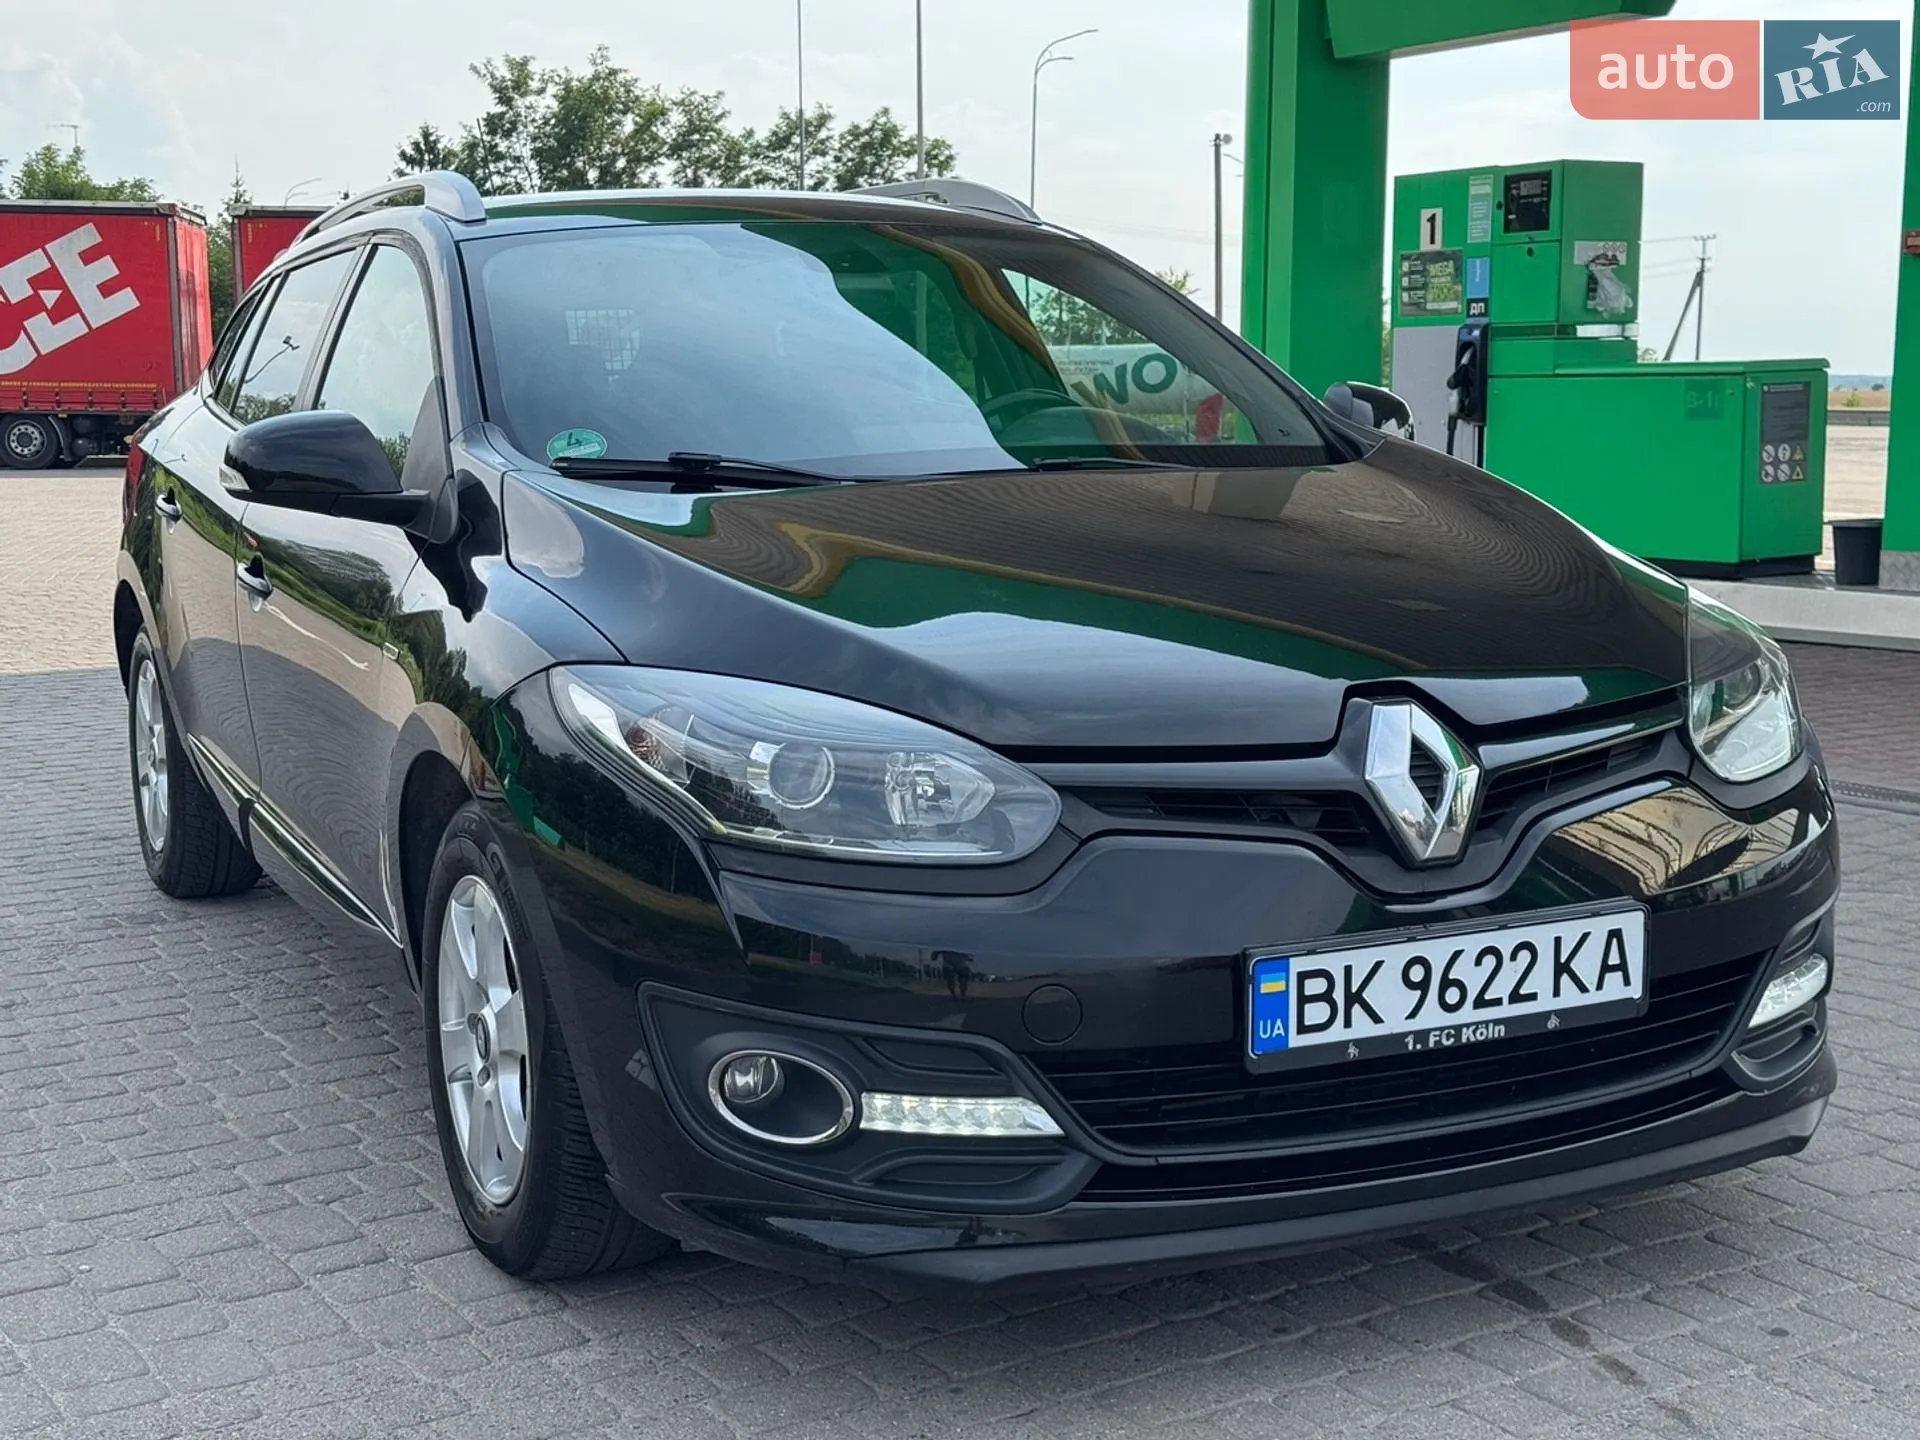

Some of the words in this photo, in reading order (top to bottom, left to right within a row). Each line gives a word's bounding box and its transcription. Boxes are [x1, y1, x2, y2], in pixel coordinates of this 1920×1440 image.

[1427, 213, 1436, 245] 1
[1296, 959, 1386, 1036] BK
[1401, 941, 1539, 1020] 9622
[1552, 927, 1632, 998] KA
[1259, 1017, 1285, 1039] UA
[1404, 1034, 1422, 1050] 1.
[1428, 1029, 1455, 1048] FC
[1461, 1022, 1506, 1043] Köln
